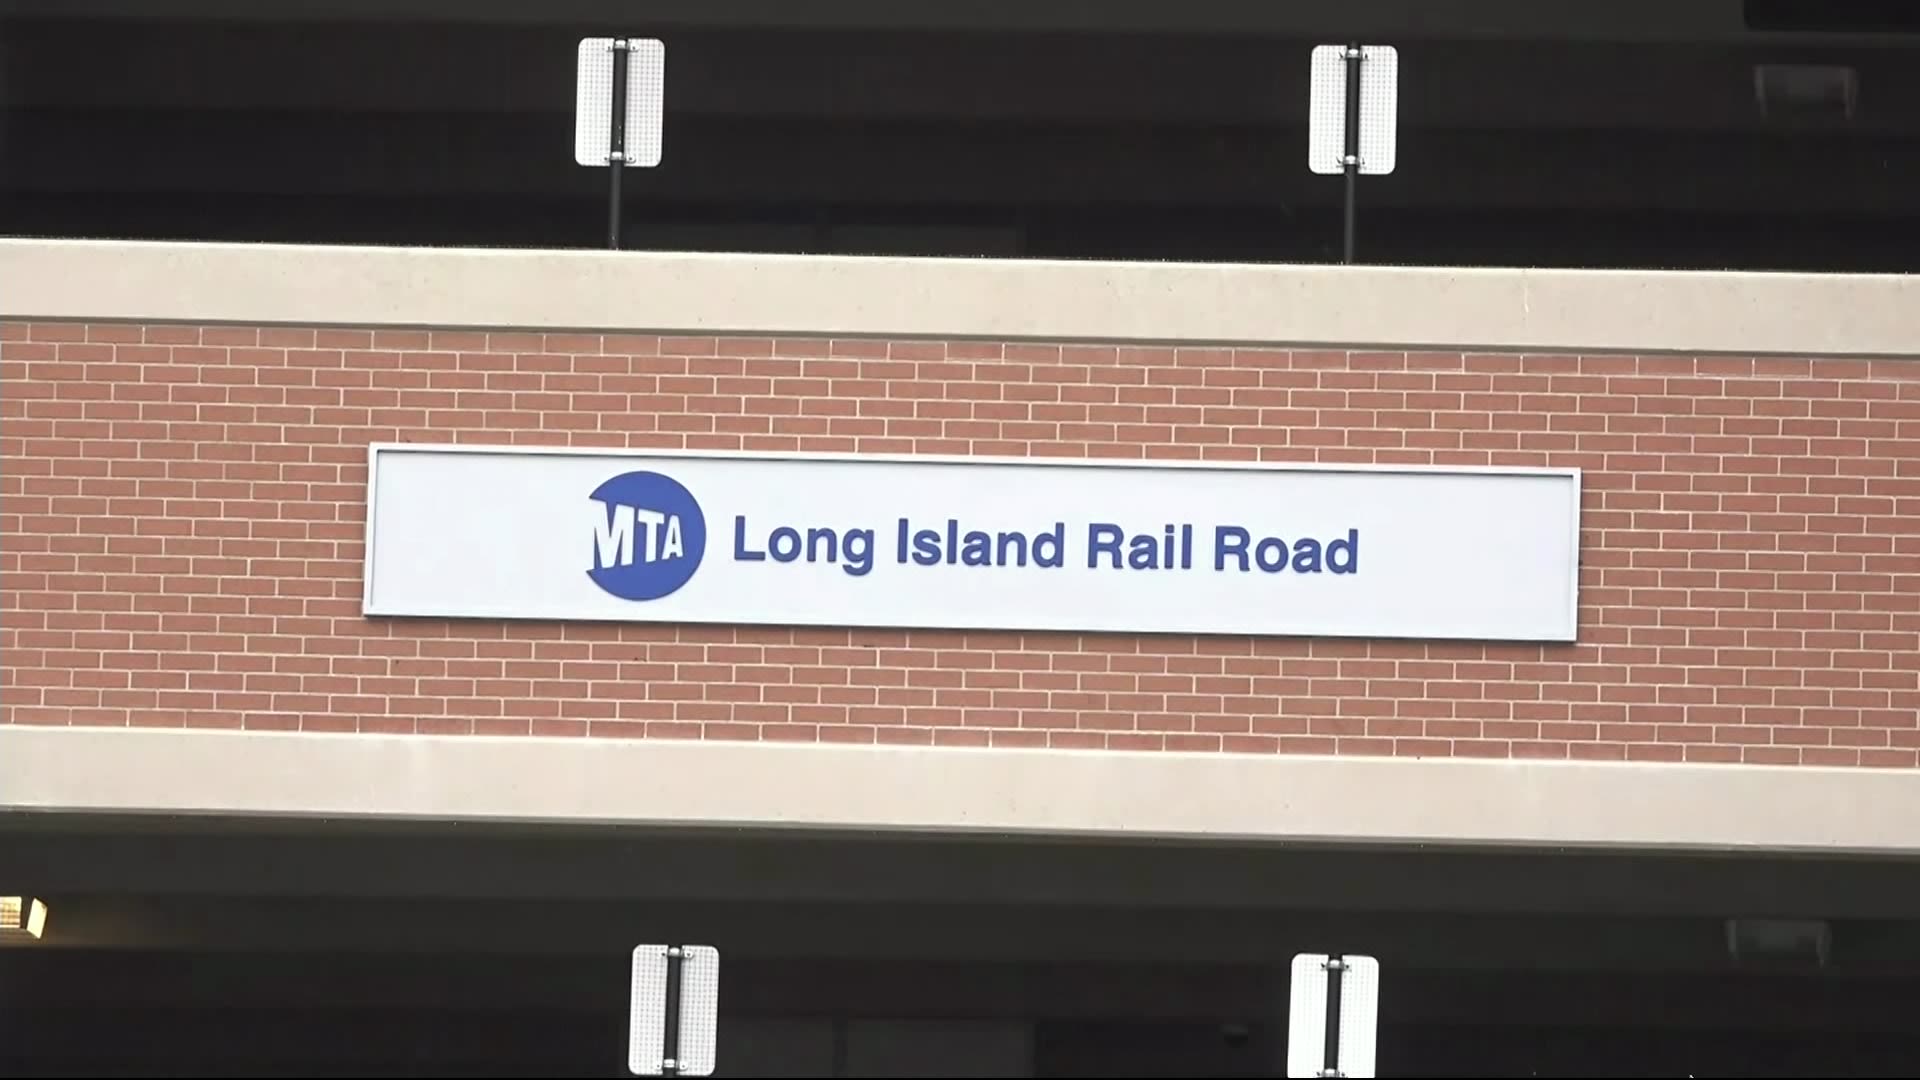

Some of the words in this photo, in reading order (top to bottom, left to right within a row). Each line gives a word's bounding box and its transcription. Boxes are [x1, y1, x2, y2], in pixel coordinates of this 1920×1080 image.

[592, 498, 684, 570] MTA
[733, 515, 875, 577] Long
[897, 519, 1065, 568] Island
[1088, 523, 1193, 570] Rail
[1215, 526, 1359, 575] Road
